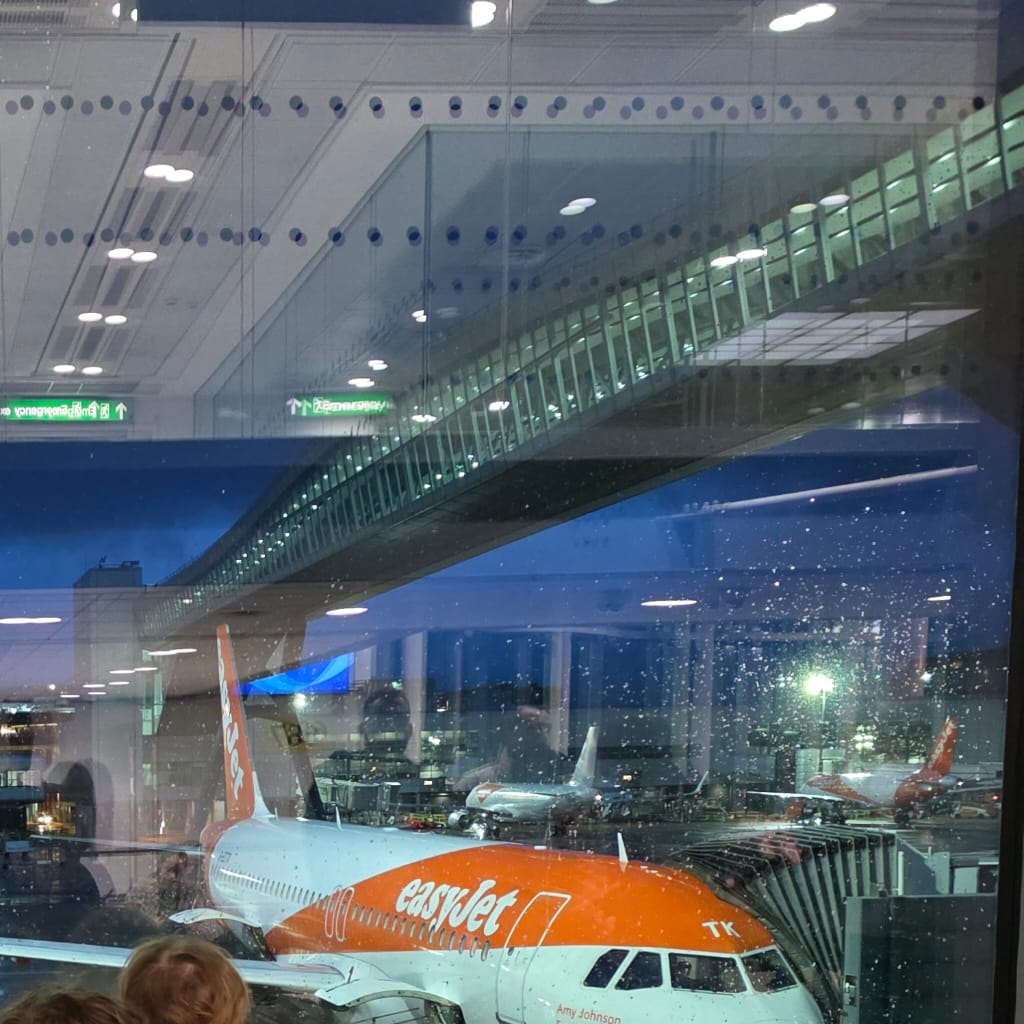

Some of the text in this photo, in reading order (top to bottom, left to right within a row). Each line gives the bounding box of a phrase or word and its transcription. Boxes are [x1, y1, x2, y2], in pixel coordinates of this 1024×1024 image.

[396, 878, 519, 936] easyJet
[701, 920, 741, 938] TK
[557, 1004, 576, 1020] Amy
